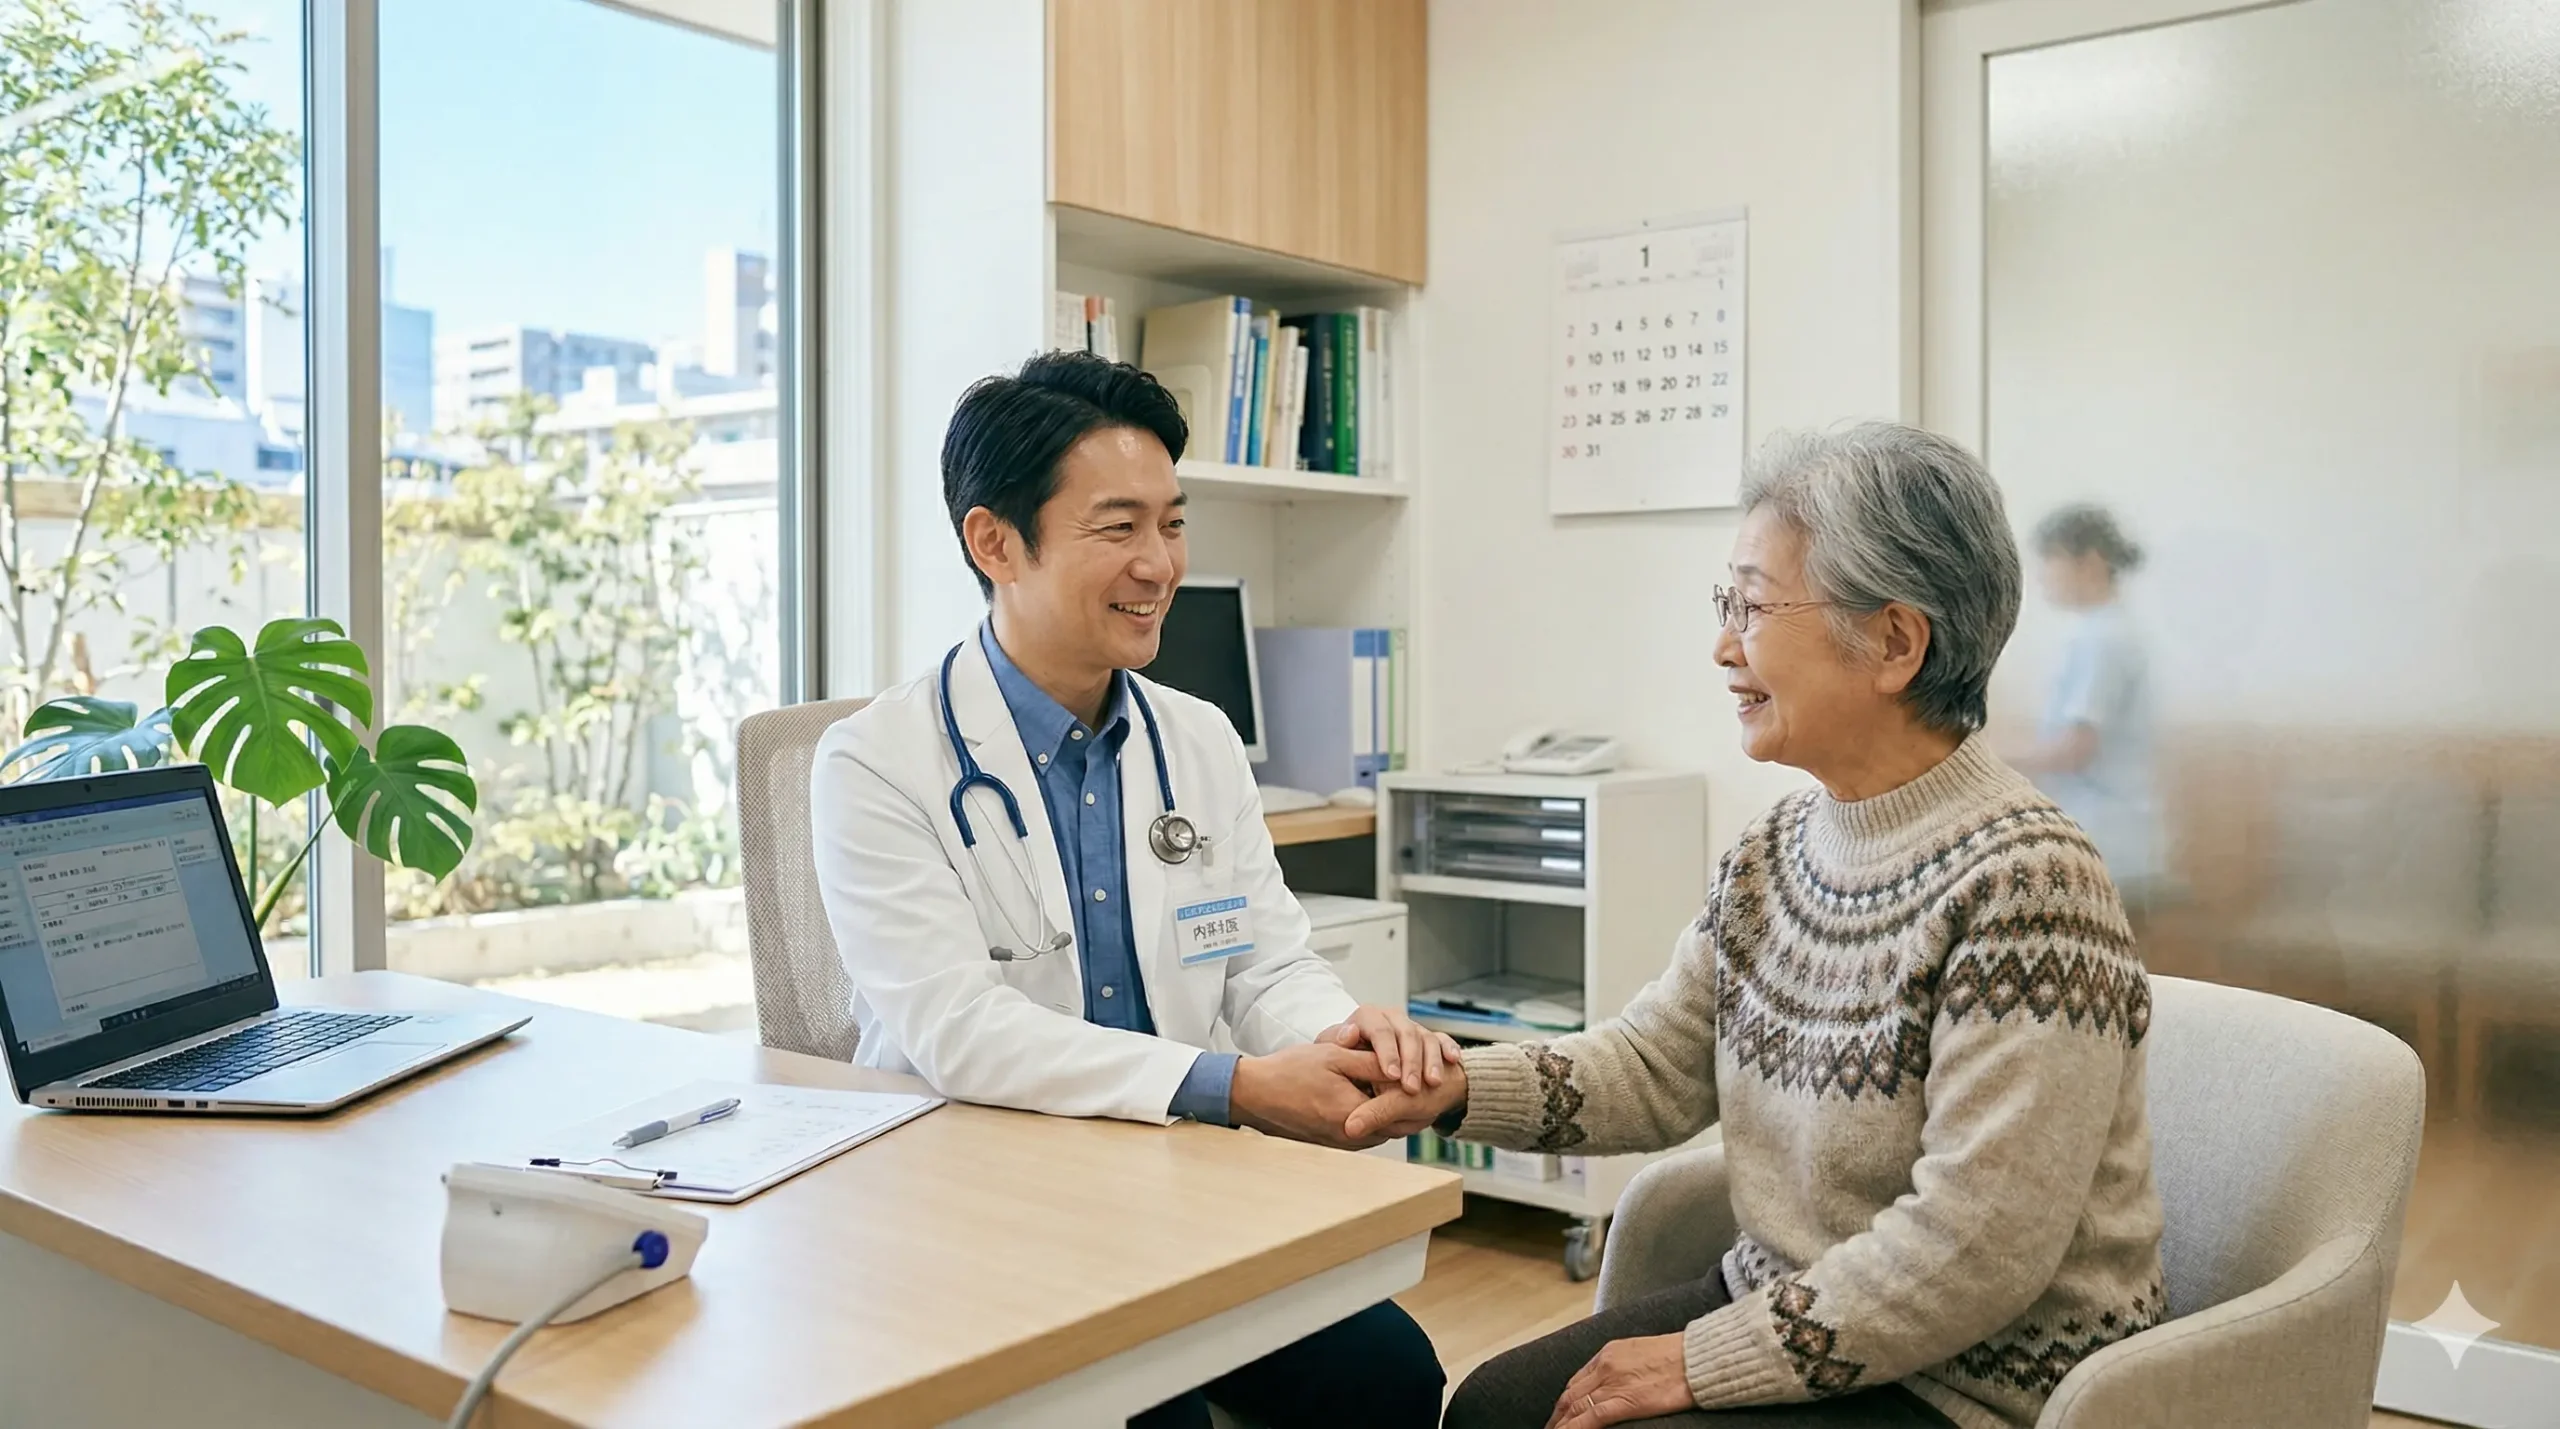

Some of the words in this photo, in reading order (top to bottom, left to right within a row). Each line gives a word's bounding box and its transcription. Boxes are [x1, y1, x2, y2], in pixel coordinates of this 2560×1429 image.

[1640, 245, 1650, 268] 1
[1567, 325, 1575, 339] 2
[1591, 323, 1599, 337] 3
[1614, 319, 1623, 332] 4
[1640, 317, 1648, 331] 5
[1665, 315, 1673, 329] 6
[1690, 311, 1699, 326] 7
[1588, 352, 1602, 366] 10
[1612, 350, 1624, 364] 11
[1637, 348, 1651, 362] 12
[1663, 345, 1676, 360] 13
[1688, 343, 1702, 356] 14
[1714, 340, 1728, 355] 15
[1588, 381, 1602, 395] 17
[1613, 381, 1625, 395] 18
[1637, 378, 1651, 392] 19
[1661, 377, 1677, 392] 20
[1686, 375, 1700, 389] 21
[1712, 372, 1728, 387] 22
[1562, 415, 1577, 429] 23
[1587, 413, 1601, 427] 24
[1610, 411, 1626, 426] 25
[1635, 410, 1650, 425] 26
[1660, 407, 1676, 423] 27
[1686, 406, 1701, 421] 28
[1712, 404, 1728, 419] 29
[1586, 444, 1600, 458] 31
